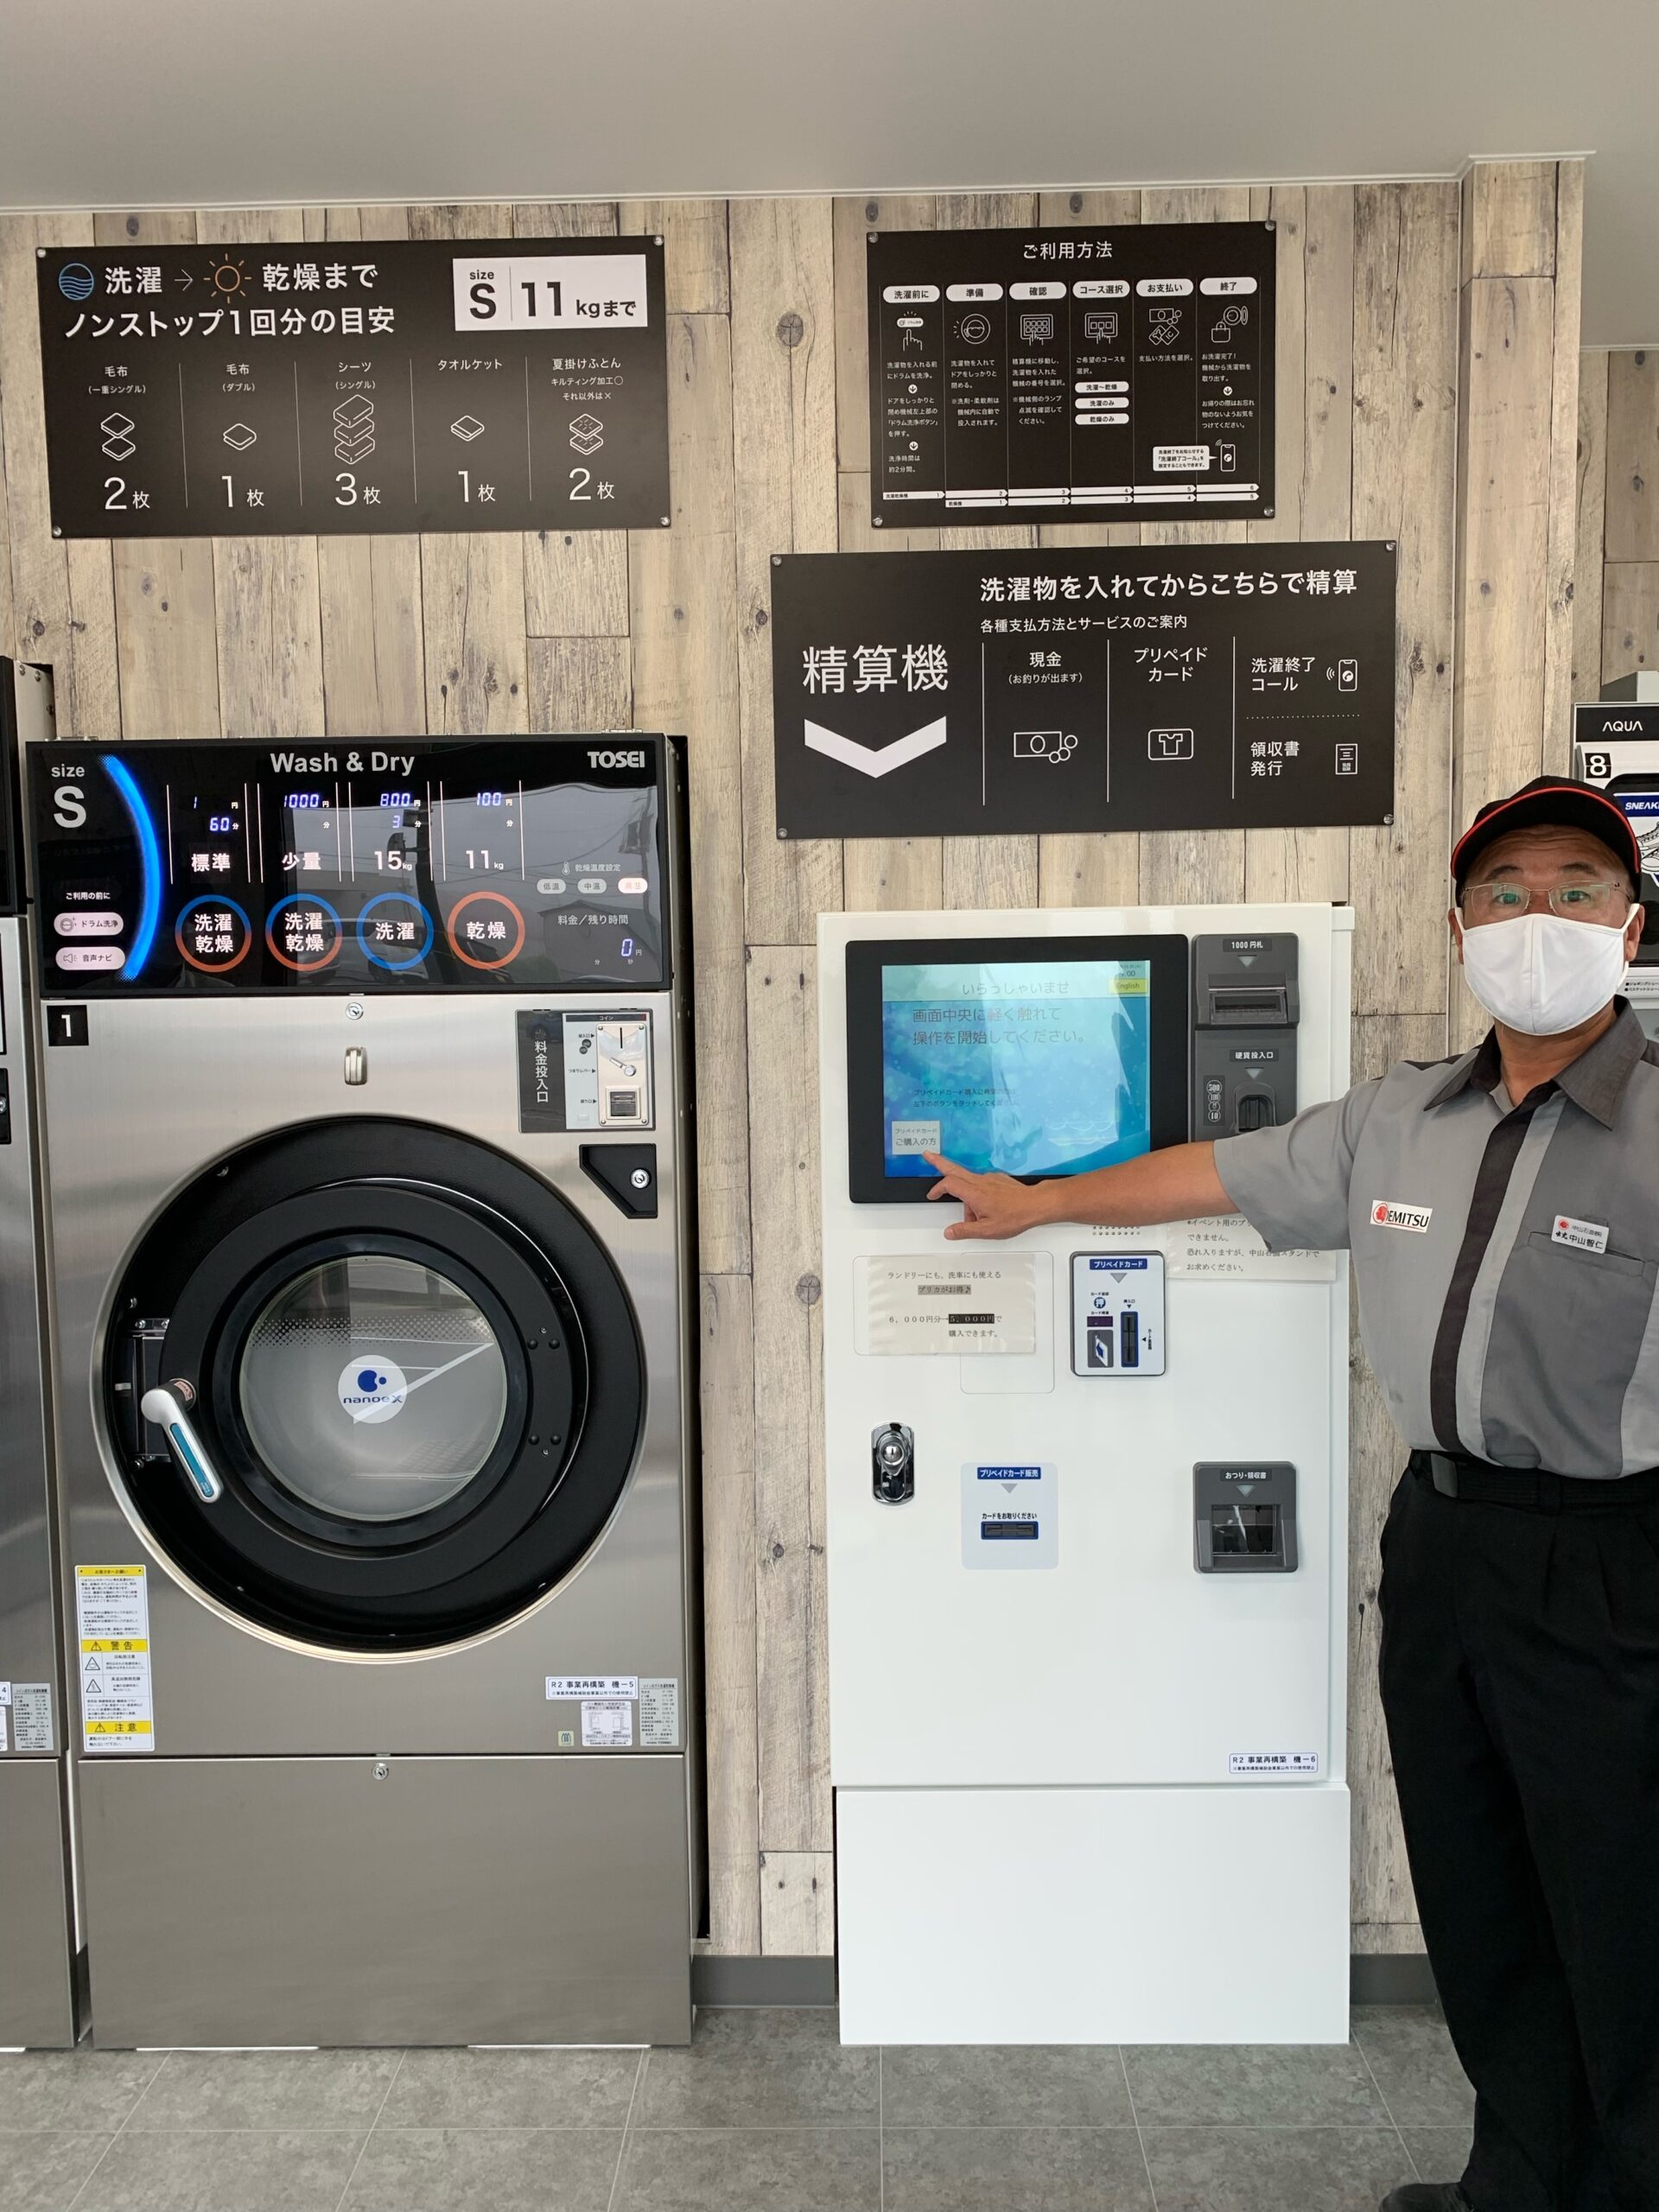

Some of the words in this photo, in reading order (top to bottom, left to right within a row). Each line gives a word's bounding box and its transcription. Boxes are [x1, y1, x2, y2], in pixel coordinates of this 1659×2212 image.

[1023, 241, 1113, 260] ご利用方法
[105, 266, 163, 294] 洗濯
[263, 263, 378, 292] 乾燥まで
[469, 270, 495, 281] size
[893, 289, 930, 300] 洗濯前に
[965, 288, 984, 298] 準備
[1029, 287, 1047, 296] 確認
[1080, 284, 1123, 295] コース選択
[1147, 283, 1184, 293] お支払い
[1220, 282, 1237, 291] 終了
[469, 283, 497, 320] S
[66, 306, 395, 338] ノンストップ1回分の目安
[105, 365, 128, 378] 毛布
[226, 363, 250, 376] 毛布
[338, 361, 372, 373] シーツ
[437, 359, 503, 372] タオルケット
[552, 358, 621, 370] 夏掛けふとん
[222, 383, 256, 393] (ダブル)
[335, 380, 376, 391] (シングル)
[980, 569, 1357, 602] 洗濯物を入れてからこちらで精算
[980, 615, 1188, 633] 各種支払方法とサービスのご案内
[1029, 652, 1062, 668] 現金
[1134, 646, 1209, 664] プリペイド
[803, 644, 949, 694] 精算機
[1251, 656, 1316, 674] 洗濯終了
[1148, 666, 1194, 683] カード
[1251, 677, 1299, 691] コール
[1250, 741, 1300, 758] 領収書
[270, 753, 339, 772] Wash
[346, 752, 364, 772] &
[371, 751, 415, 777] Dry
[587, 751, 645, 769] TOSEI
[1589, 754, 1607, 776] 8
[51, 763, 86, 778] size
[1250, 760, 1283, 777] 発行
[53, 785, 87, 829] S
[191, 852, 231, 873] 標準
[282, 851, 321, 871] 少量
[584, 882, 601, 891] 中温
[66, 892, 111, 900] ご利用の前に
[81, 919, 118, 928] ドラム洗浄
[194, 914, 232, 932] 洗濯
[285, 912, 323, 931] 洗濯
[375, 921, 415, 942] 洗濯
[467, 921, 506, 941] 乾燥
[194, 935, 234, 953] 乾燥
[285, 933, 324, 951] 乾燥
[82, 954, 112, 963] 音声ナビ
[962, 982, 1070, 995] いらっしゃいませ
[912, 1007, 1063, 1023] 画面中央に軽く触れて
[61, 1014, 72, 1038] 1
[912, 1029, 1085, 1046] 操作を開始してください。
[534, 1040, 549, 1103] 料金投入口
[895, 1137, 938, 1147] ご購入の方
[887, 1271, 1001, 1280] ランドリーにも、洗車にも使える
[111, 1641, 133, 1650] 警告
[114, 1722, 137, 1732] 注意
